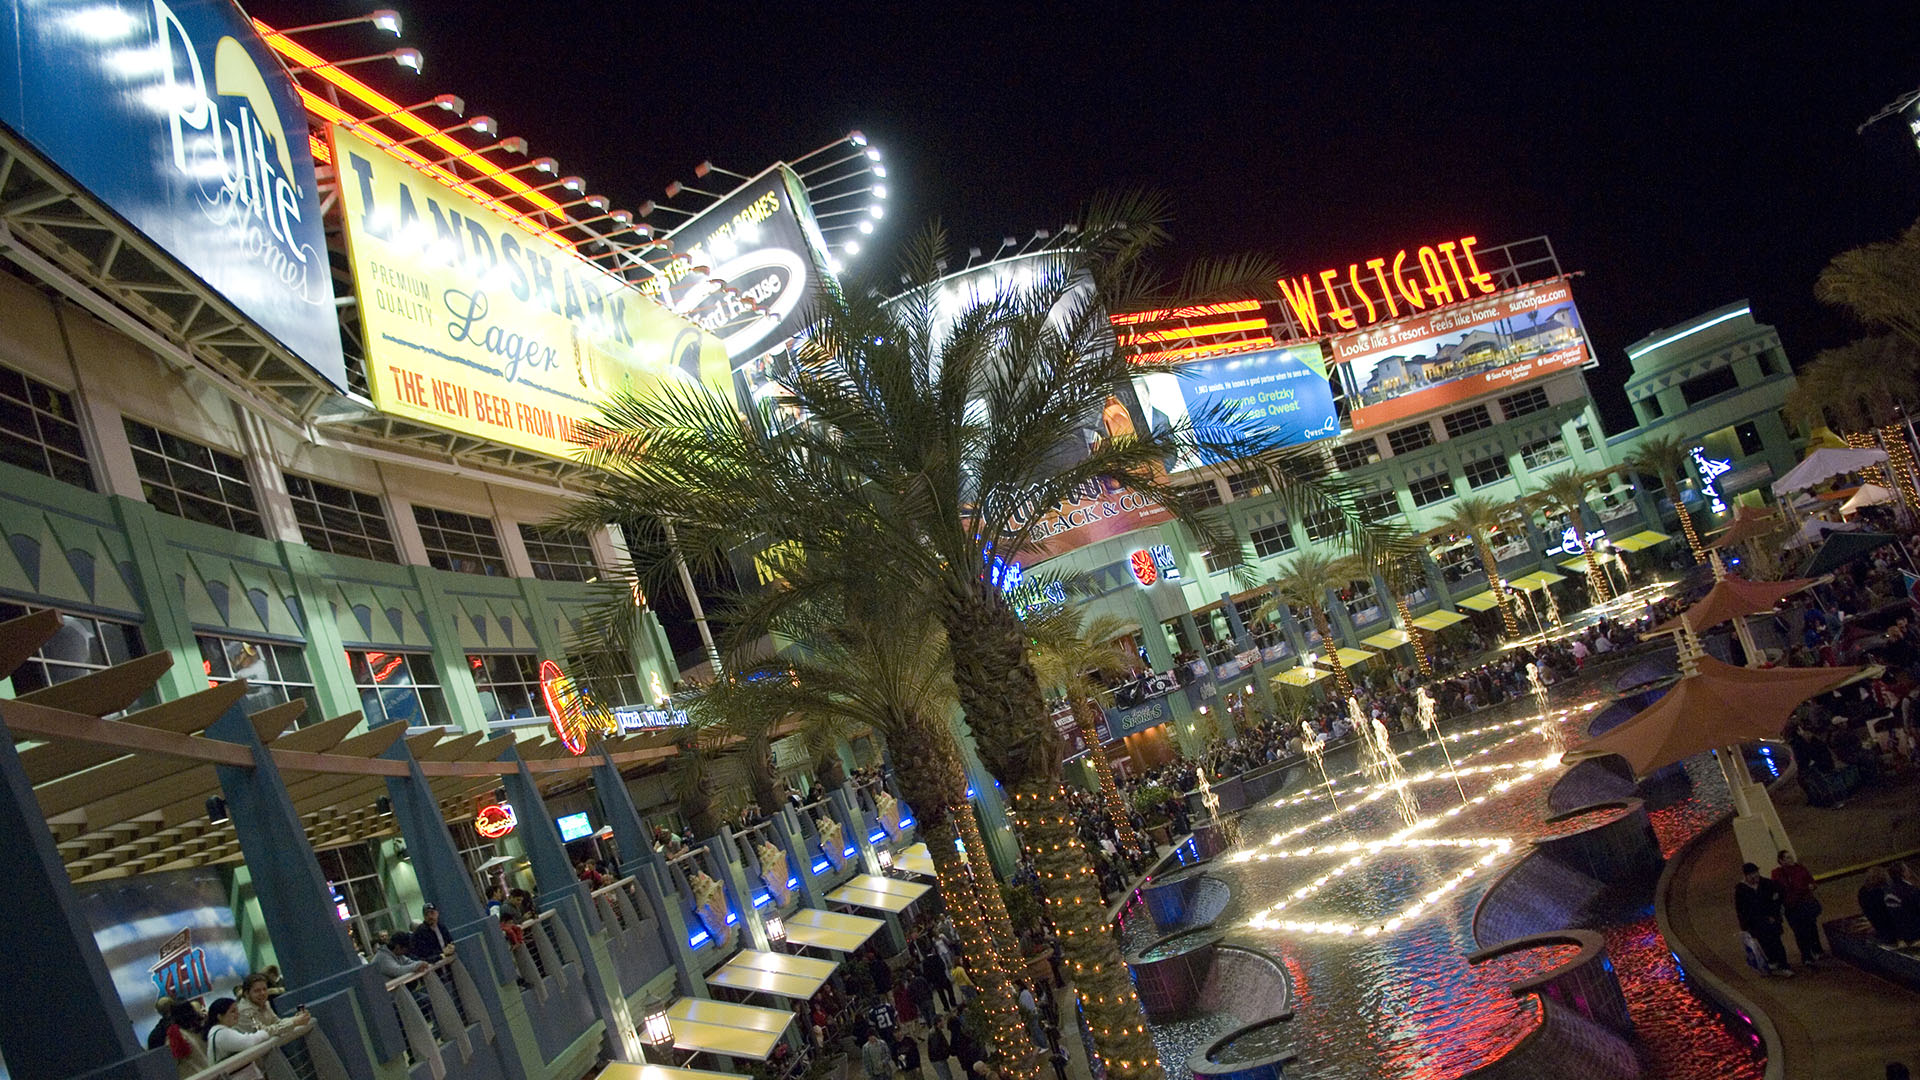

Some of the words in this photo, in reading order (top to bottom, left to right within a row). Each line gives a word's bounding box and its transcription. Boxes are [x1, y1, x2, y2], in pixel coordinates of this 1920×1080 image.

[153, 0, 306, 262] Pulte
[370, 261, 431, 301] PREMIUM
[1278, 236, 1496, 338] WESTGATE
[1508, 288, 1567, 313] suncityaz.com
[376, 288, 433, 327] QUALITY
[444, 288, 560, 382] Lager
[1339, 339, 1370, 358] Looks
[1370, 336, 1389, 351] like
[1389, 334, 1397, 345] a
[1397, 325, 1429, 343] resort.
[1429, 318, 1454, 334] Feels
[1454, 312, 1471, 328] like
[1471, 306, 1500, 324] home.
[389, 365, 429, 408] THE
[431, 377, 469, 419] NEW
[473, 390, 513, 429] BEER
[515, 401, 556, 440] FROM
[1257, 388, 1296, 403] Gretzky
[1267, 400, 1300, 416] Qwest
[1304, 427, 1325, 439] Qwest
[1030, 504, 1102, 544] BLACK
[1103, 501, 1120, 519] &
[876, 1012, 893, 1029] 21
